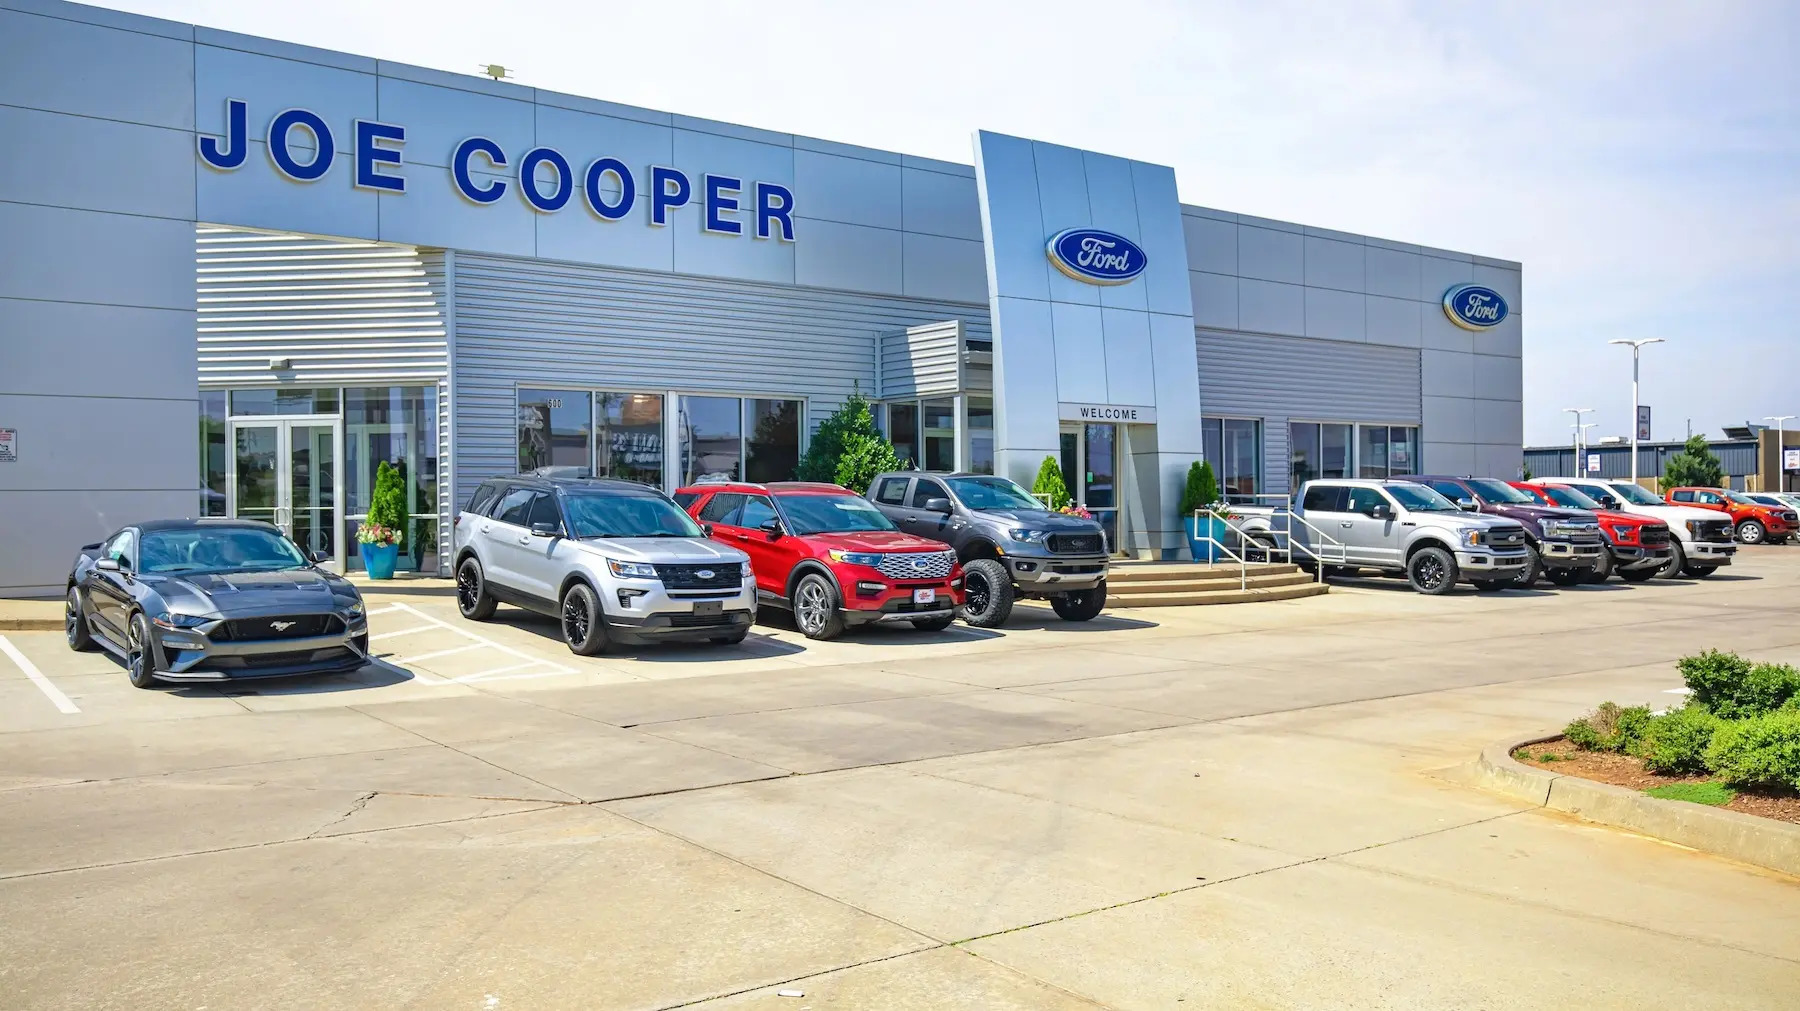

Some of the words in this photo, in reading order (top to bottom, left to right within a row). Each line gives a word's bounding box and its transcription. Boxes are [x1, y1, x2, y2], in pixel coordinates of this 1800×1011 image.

[198, 97, 407, 194] JOE
[451, 135, 797, 243] COOPER
[1077, 237, 1130, 271] Ford
[1465, 293, 1499, 320] Ford
[1080, 407, 1138, 420] WELCOME
